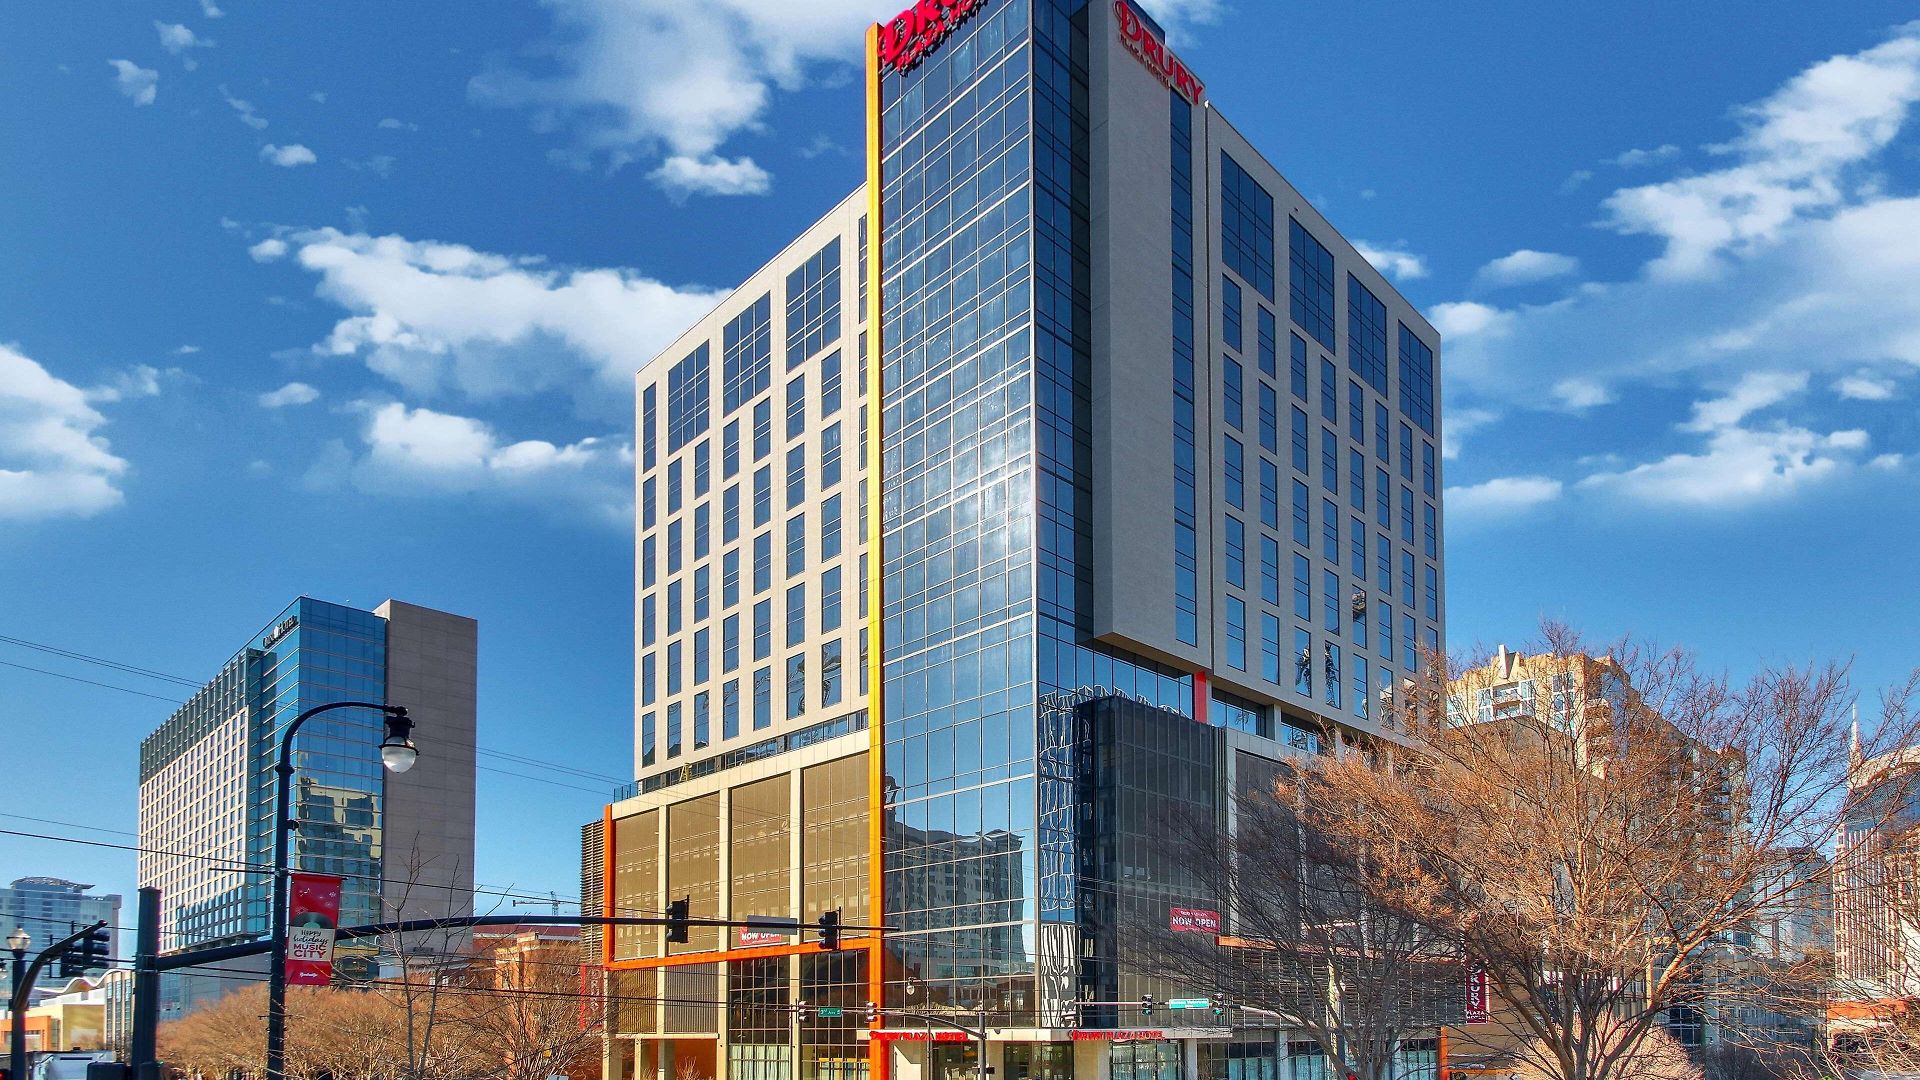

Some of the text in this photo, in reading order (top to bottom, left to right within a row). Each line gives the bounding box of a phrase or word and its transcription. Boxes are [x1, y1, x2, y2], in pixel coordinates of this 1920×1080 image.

[1113, 0, 1203, 105] DRURY
[1172, 916, 1216, 928] NOW OPEN
[301, 929, 321, 937] Happy
[741, 932, 758, 940] NOW
[293, 936, 329, 945] holidays
[293, 943, 326, 951] MUSIC
[293, 950, 326, 958] CITY
